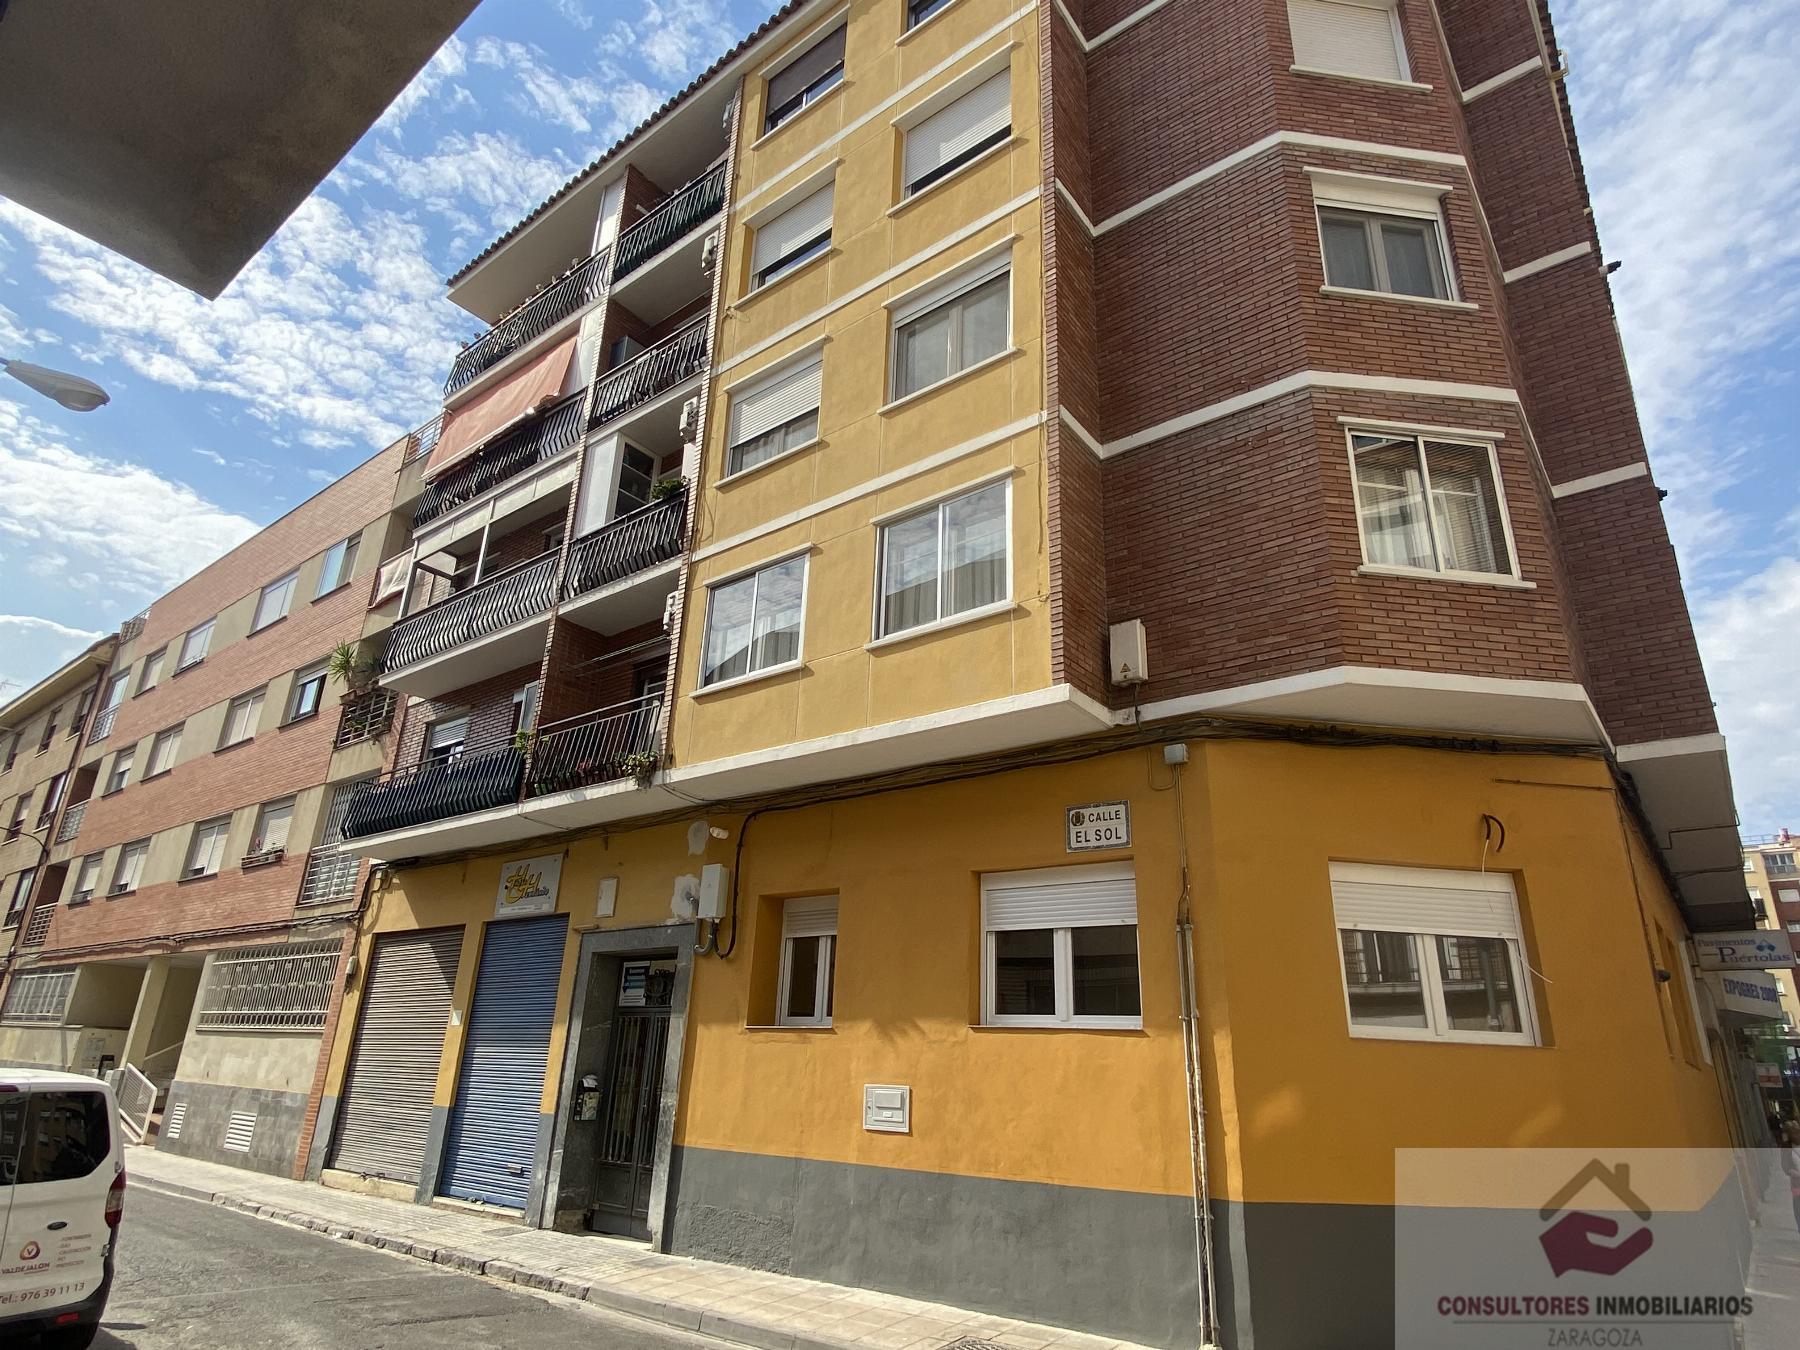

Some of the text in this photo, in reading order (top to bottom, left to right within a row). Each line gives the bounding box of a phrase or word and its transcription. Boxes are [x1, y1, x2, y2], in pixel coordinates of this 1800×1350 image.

[1088, 810, 1121, 823] CALLE
[1075, 827, 1122, 843] EL SOL
[20, 1291, 41, 1302] 976
[43, 1287, 57, 1298] 39
[60, 1285, 70, 1295] 11
[74, 1282, 85, 1292] 13
